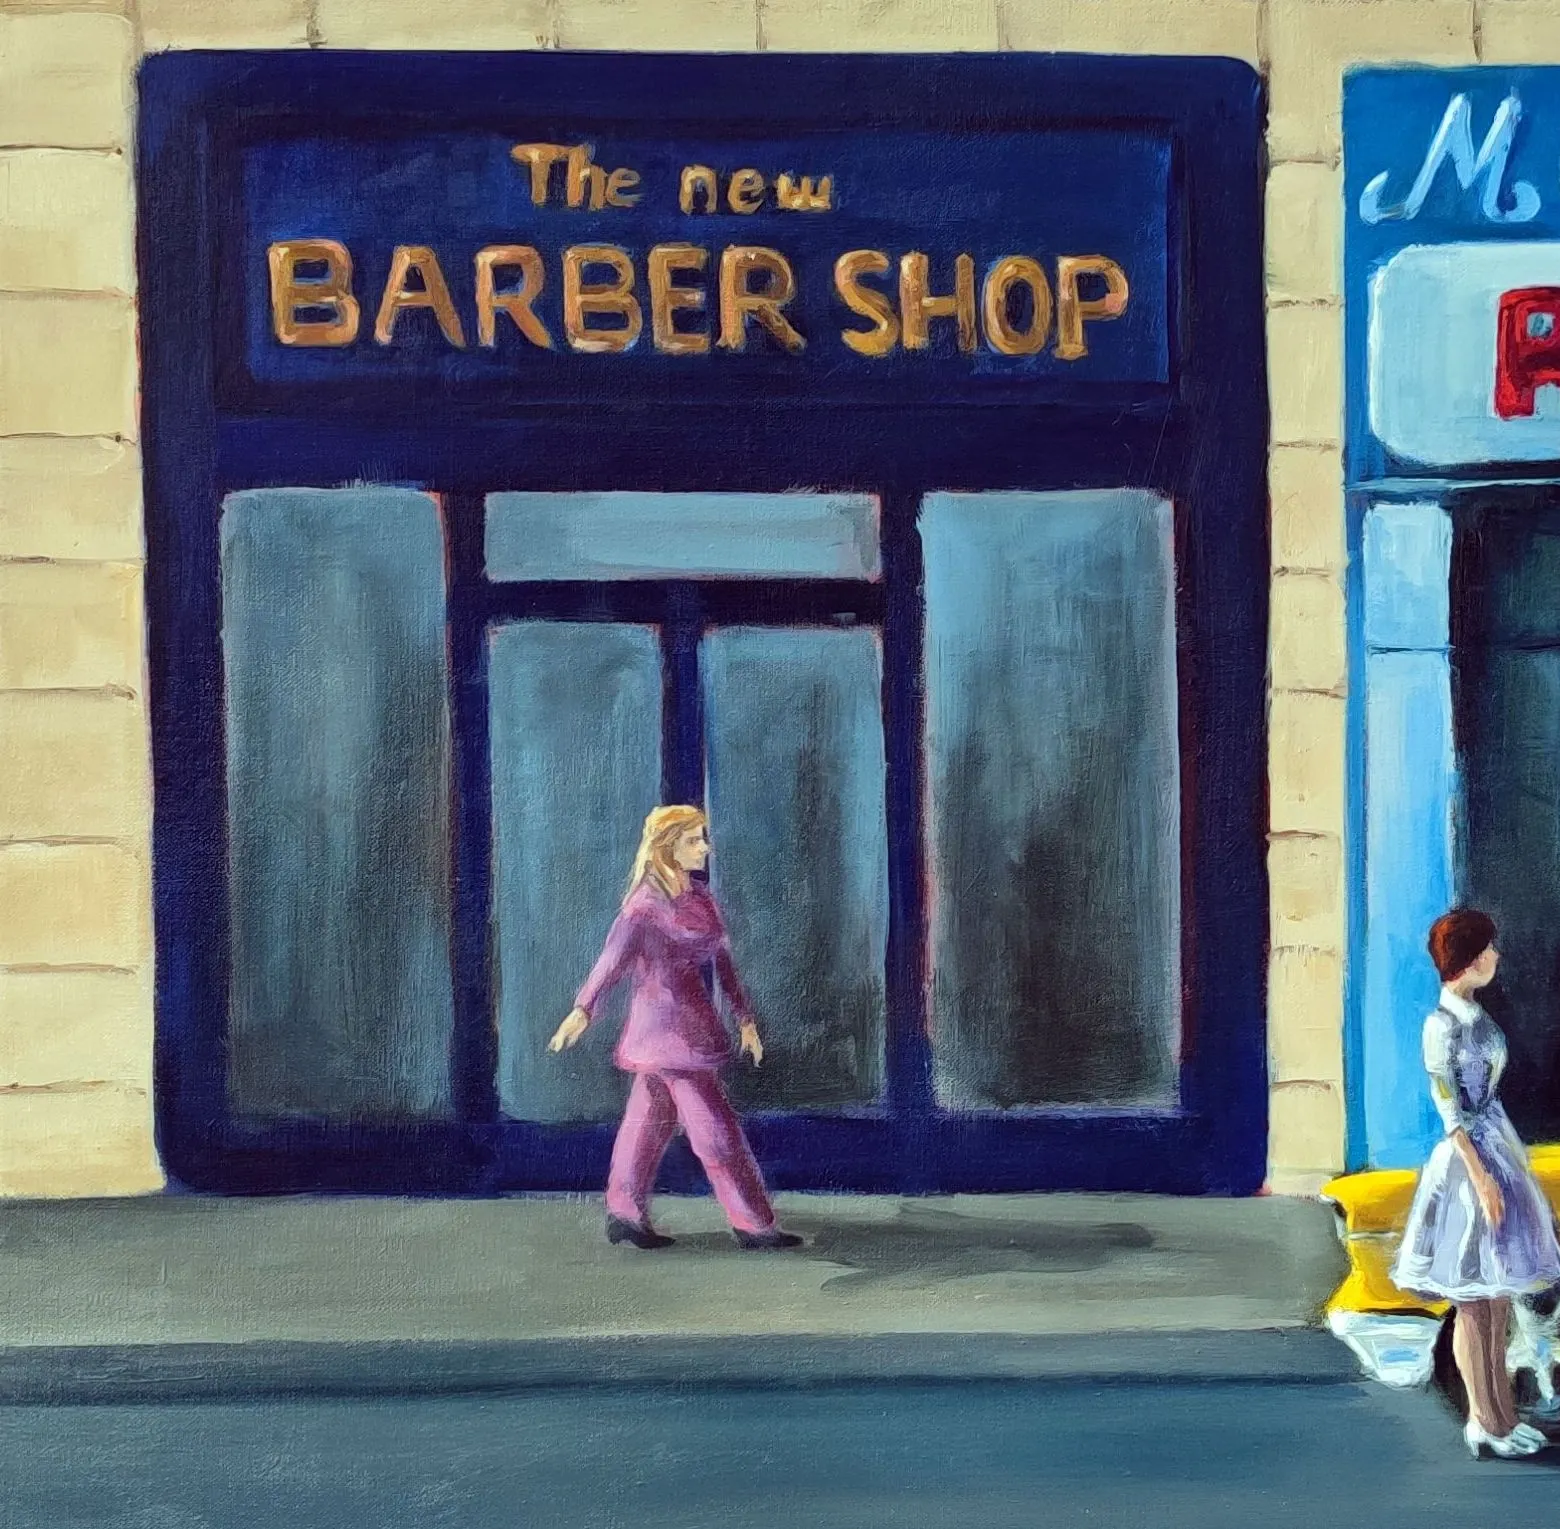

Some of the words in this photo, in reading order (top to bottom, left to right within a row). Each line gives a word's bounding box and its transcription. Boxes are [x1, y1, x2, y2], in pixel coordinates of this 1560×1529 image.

[511, 142, 641, 210] The
[677, 162, 832, 213] new
[267, 238, 806, 352] BARBER
[836, 247, 1129, 361] SHOP
